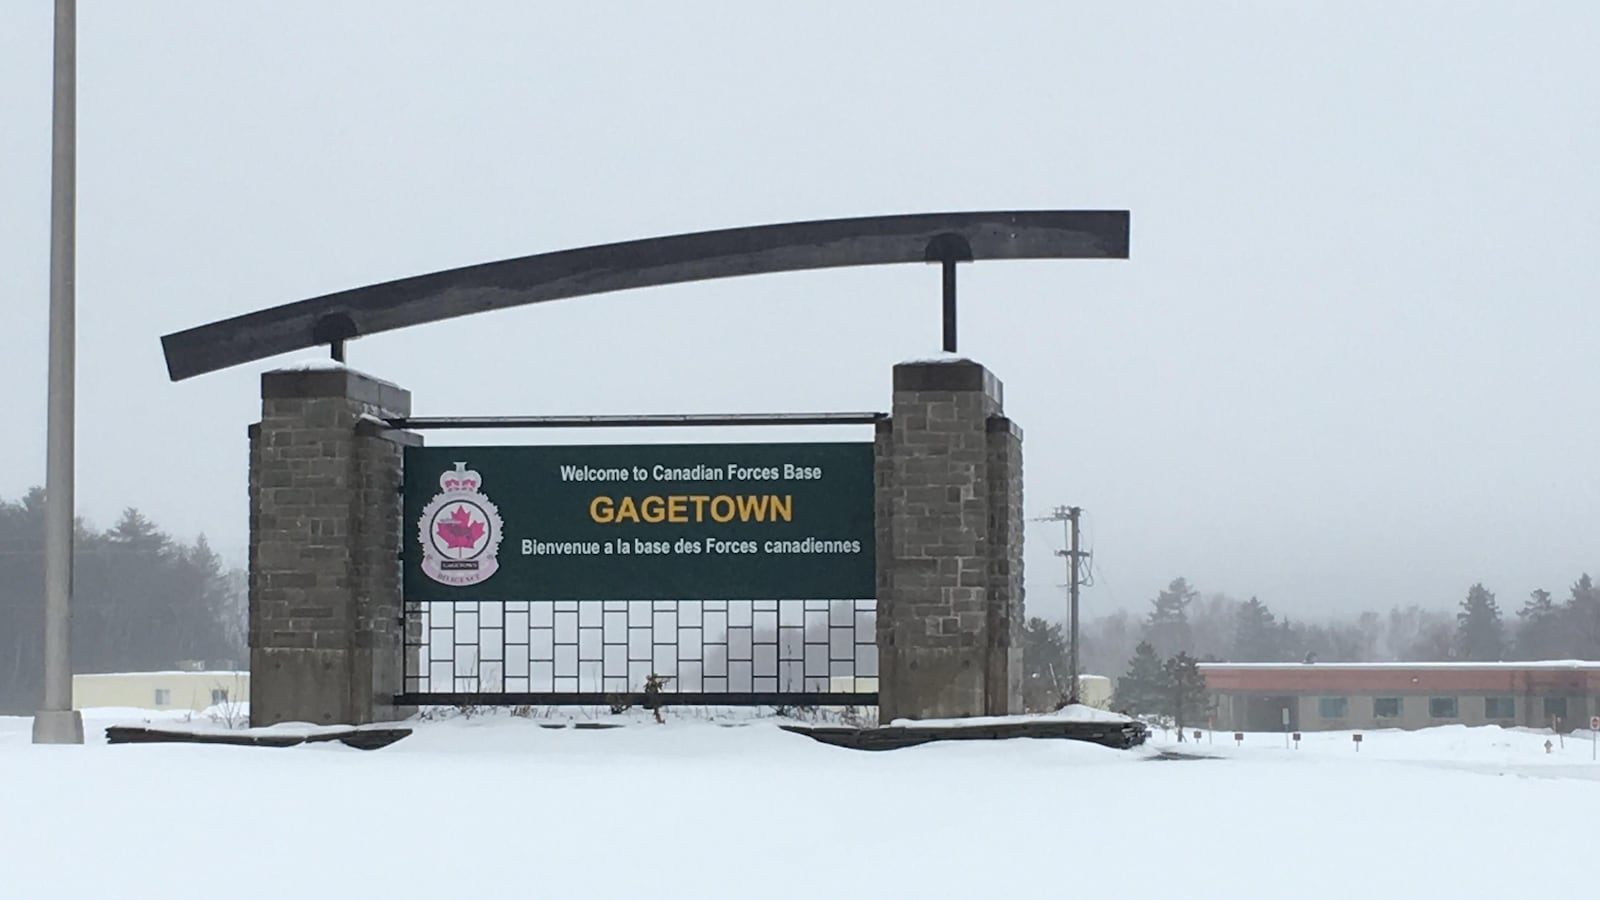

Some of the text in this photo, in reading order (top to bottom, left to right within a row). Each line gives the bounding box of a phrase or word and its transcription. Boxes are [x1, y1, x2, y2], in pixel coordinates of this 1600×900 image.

[560, 463, 822, 481] Welcome to Canadian Forces Base
[590, 495, 792, 522] GAGETOWN
[521, 537, 861, 554] Bienvenue a la base des Forces canadiennes
